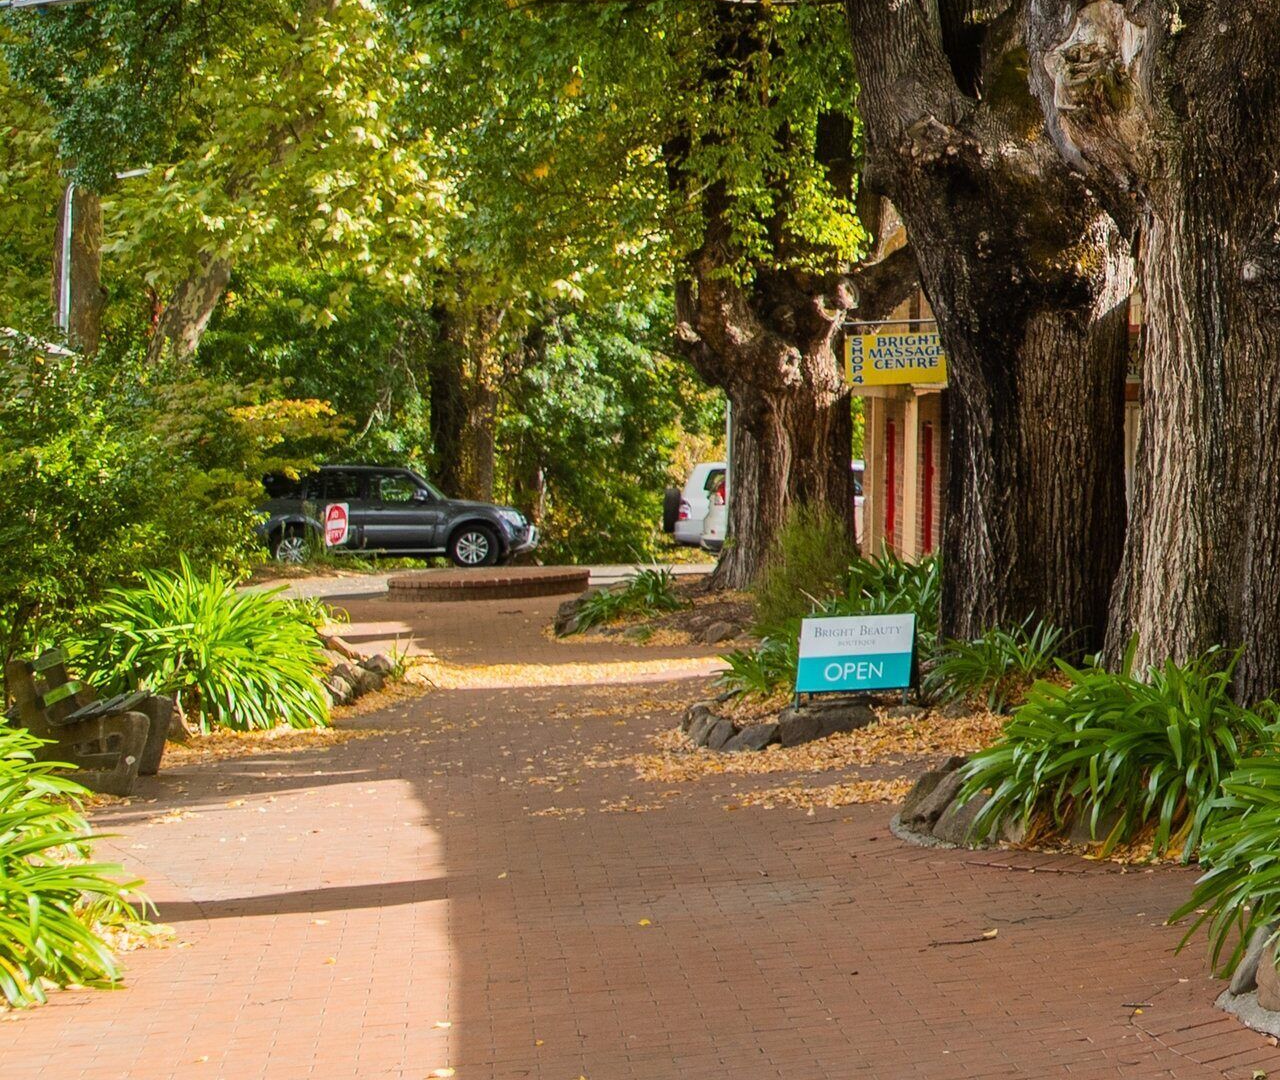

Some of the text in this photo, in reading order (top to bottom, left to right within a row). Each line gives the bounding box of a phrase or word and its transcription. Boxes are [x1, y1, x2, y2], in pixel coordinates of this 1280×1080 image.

[877, 334, 939, 347] BRIGHT
[869, 346, 945, 359] MASSAGE
[852, 337, 864, 384] SHOP 4
[874, 357, 939, 369] CENTRE
[814, 625, 902, 638] BRIGHT BEAUTY
[824, 661, 884, 682] OPEN
